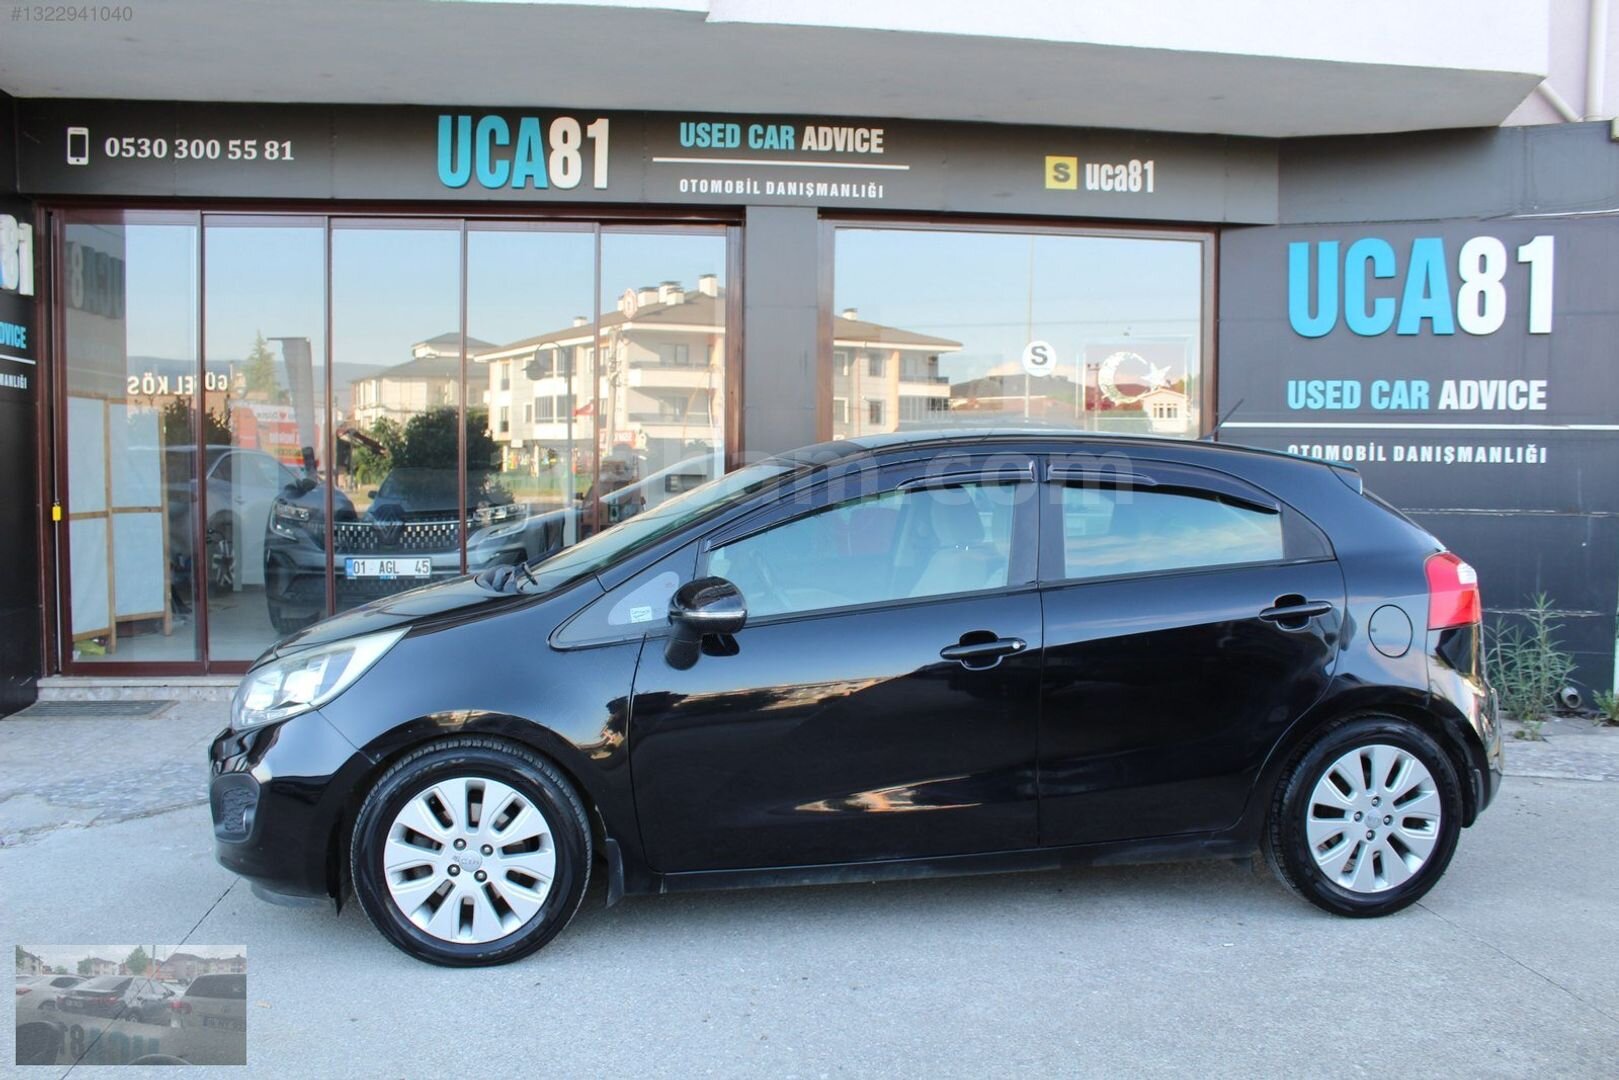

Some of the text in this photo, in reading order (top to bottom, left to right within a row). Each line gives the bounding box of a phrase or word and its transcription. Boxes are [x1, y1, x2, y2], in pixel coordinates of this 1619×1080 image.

[105, 137, 294, 161] 0530 300 55 81
[437, 115, 609, 190] UCA81
[679, 122, 884, 153] USED CAR ADVICE
[679, 178, 884, 198] OTOMOBİL DANIŞMANLIĞI
[1053, 159, 1154, 193] S uca81
[0, 213, 35, 296] 81
[1288, 235, 1555, 338] UCA81
[1030, 345, 1049, 366] S
[1287, 380, 1547, 410] USED CAR ADVICE
[1287, 442, 1547, 464] OTOMOBİL DANIŞMANLIĞI
[353, 560, 429, 574] 01 AGL 45
